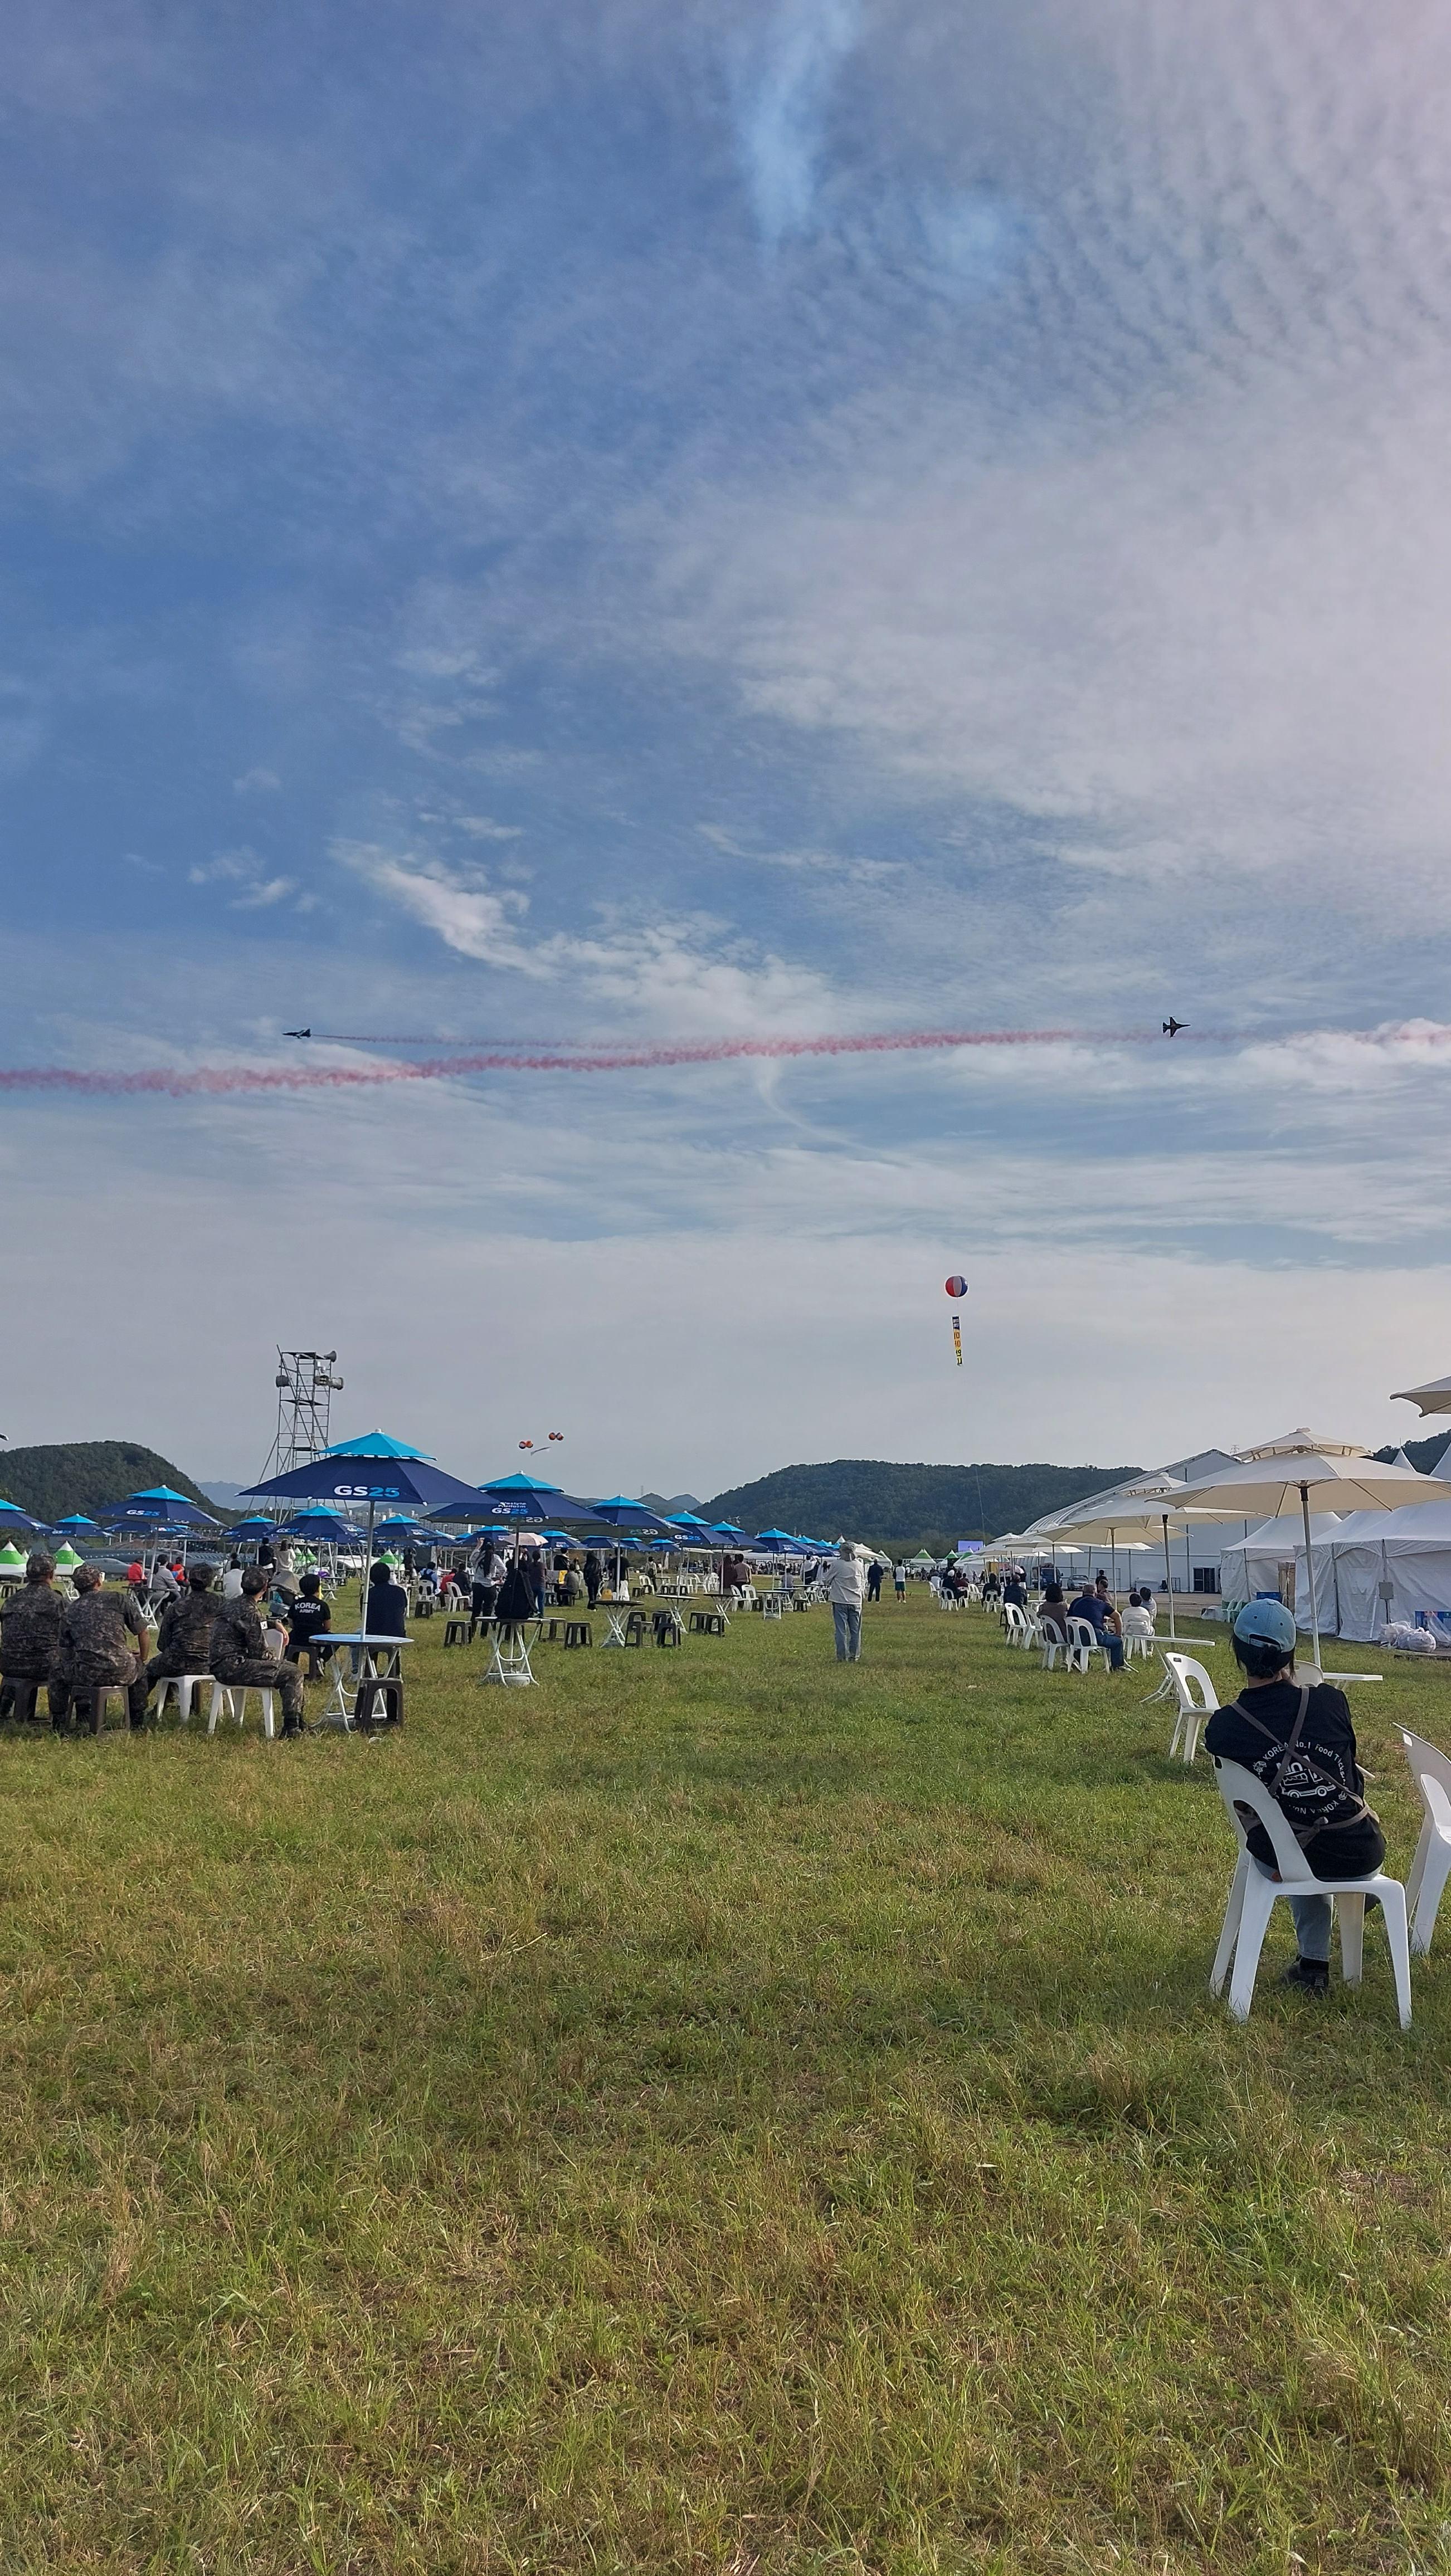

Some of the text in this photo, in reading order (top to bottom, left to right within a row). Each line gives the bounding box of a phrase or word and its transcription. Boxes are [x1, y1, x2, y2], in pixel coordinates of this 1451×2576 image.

[334, 1485, 400, 1497] GS25
[295, 1602, 321, 1612] KOREA
[1315, 1744, 1333, 1757] Food
